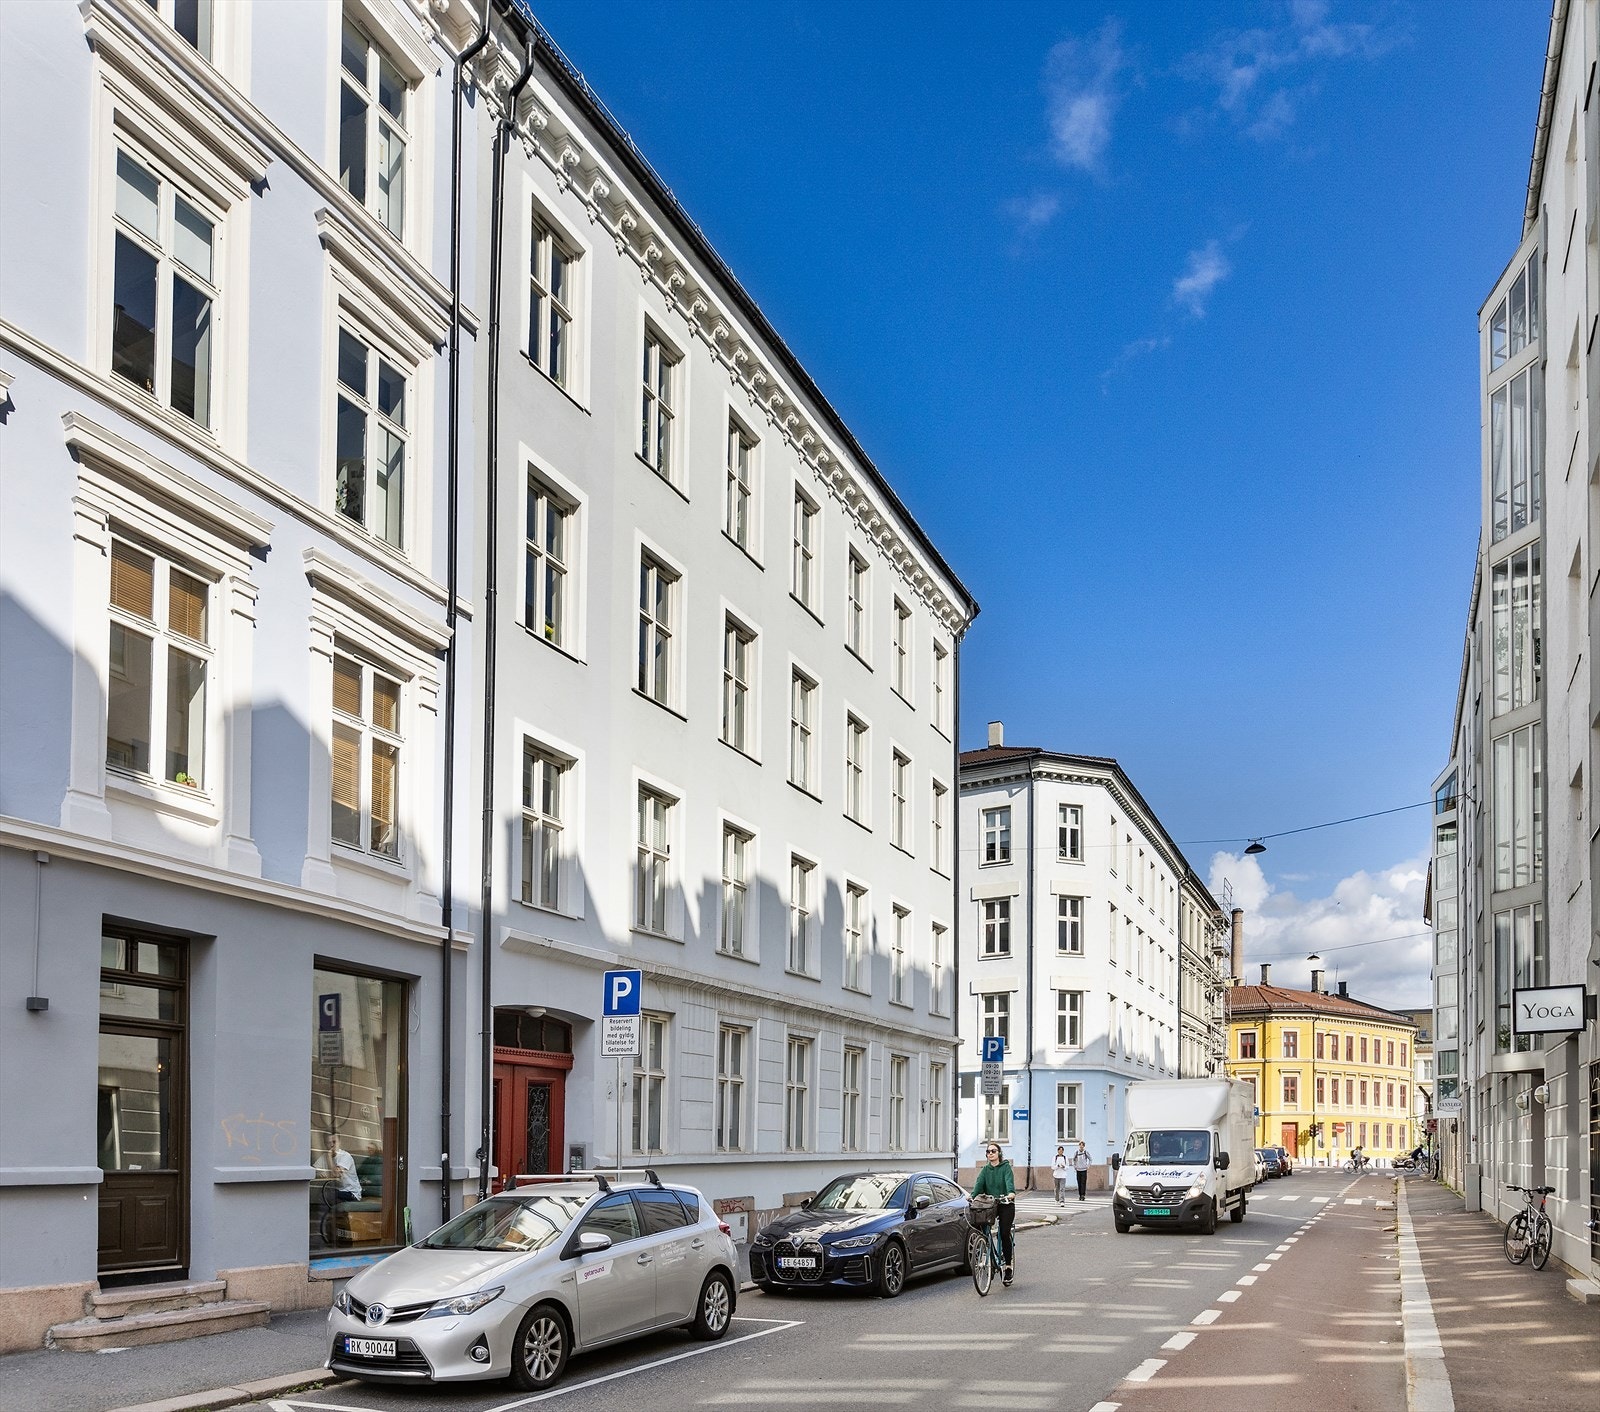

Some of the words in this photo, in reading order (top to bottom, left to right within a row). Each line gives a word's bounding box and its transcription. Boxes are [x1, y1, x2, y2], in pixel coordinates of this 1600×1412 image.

[612, 976, 632, 1010] P
[1522, 1003, 1575, 1019] YOGA
[987, 1040, 999, 1058] P
[792, 1259, 814, 1267] 64857
[583, 1265, 605, 1279] getaround
[351, 1340, 361, 1353] RK
[365, 1341, 394, 1355] 90044
